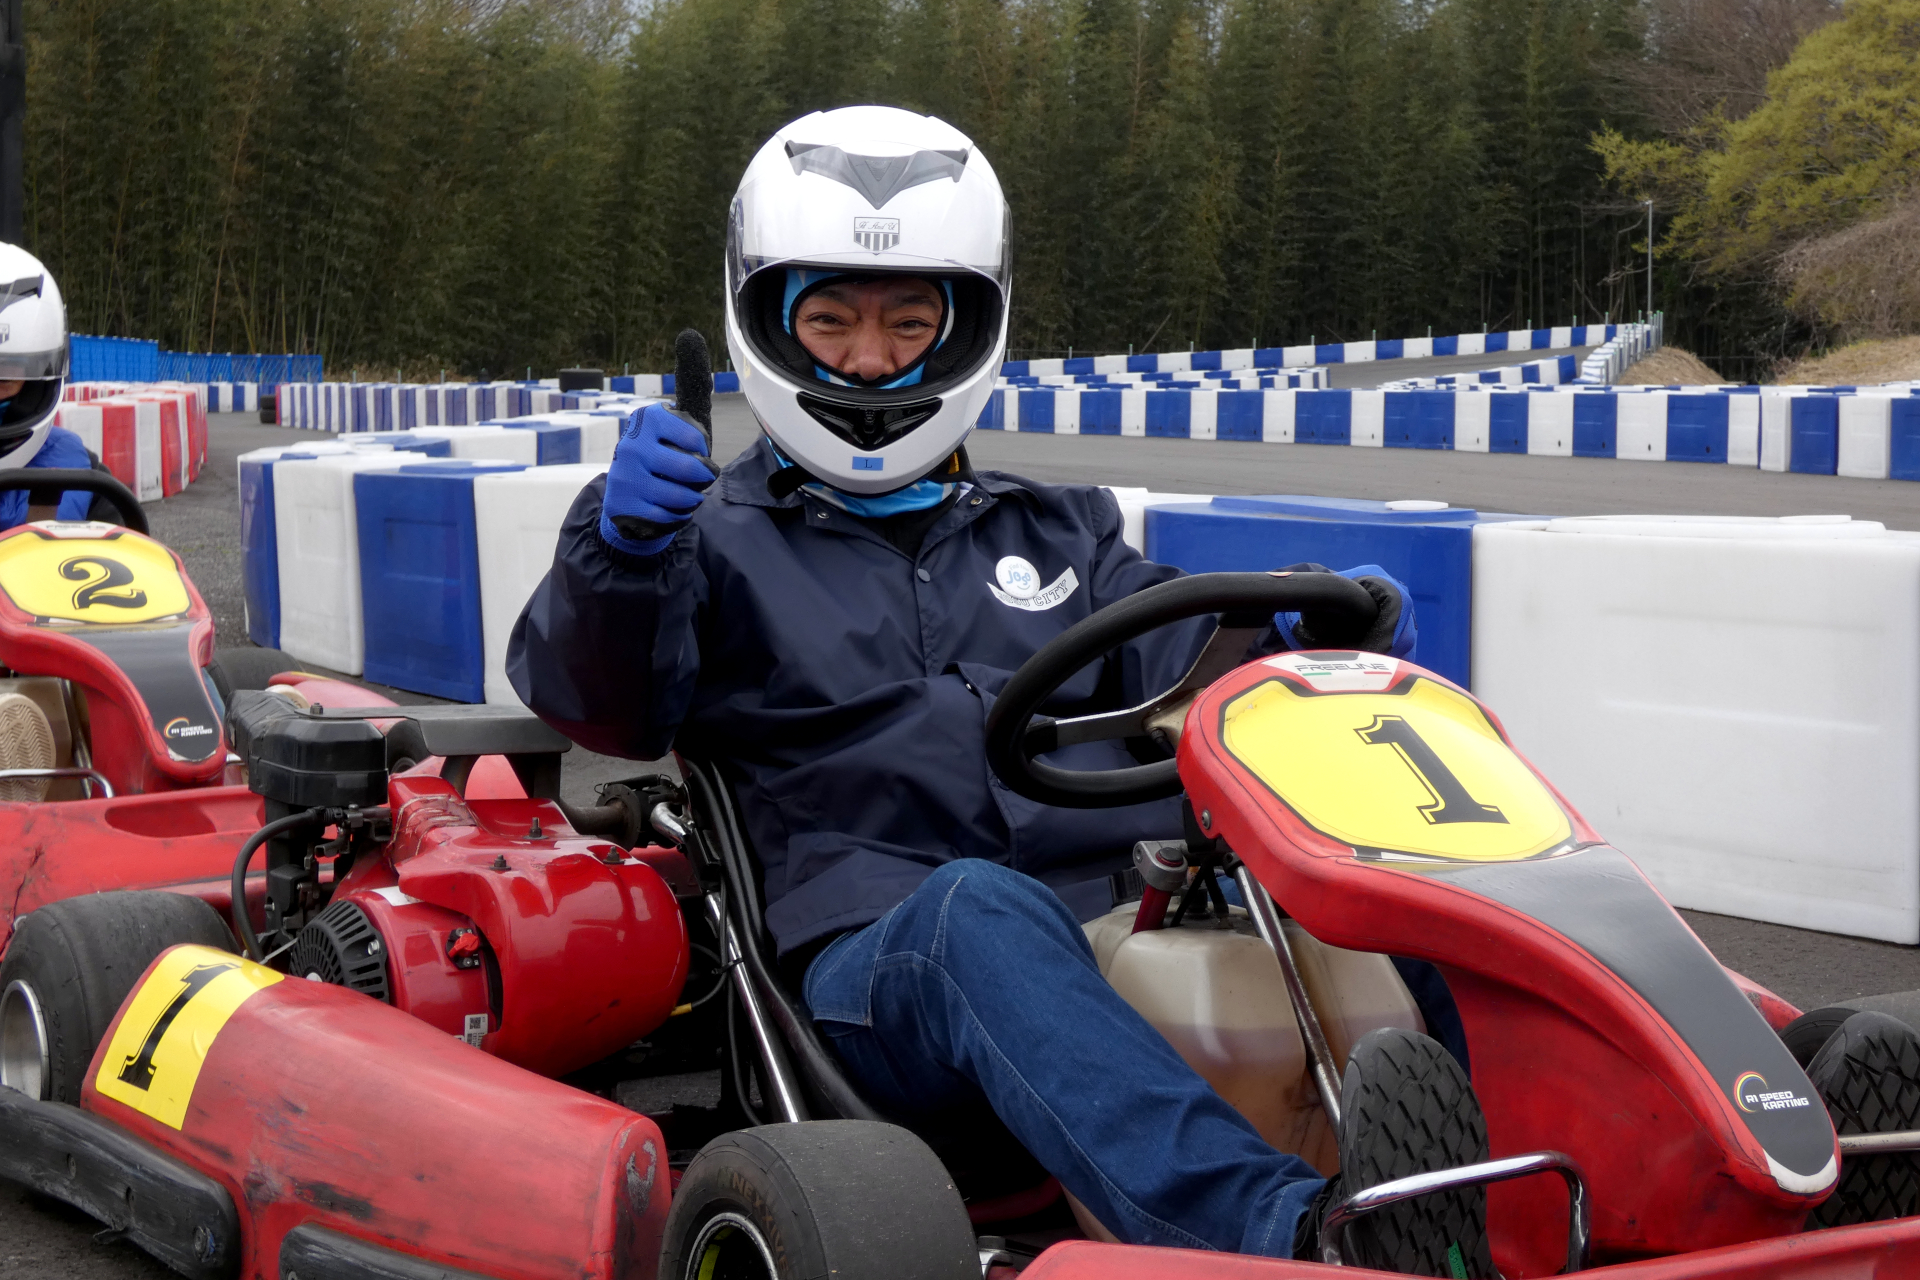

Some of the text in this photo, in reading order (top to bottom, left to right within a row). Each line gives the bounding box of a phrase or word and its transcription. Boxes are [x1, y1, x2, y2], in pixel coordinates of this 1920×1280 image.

[864, 459, 873, 469] L
[58, 555, 148, 611] 2
[1032, 579, 1069, 607] CITY
[1294, 663, 1389, 672] FREELINE
[1353, 714, 1511, 825] 1
[117, 962, 242, 1092] 1
[1759, 1090, 1794, 1102] SPEED
[1762, 1097, 1810, 1111] KARTING
